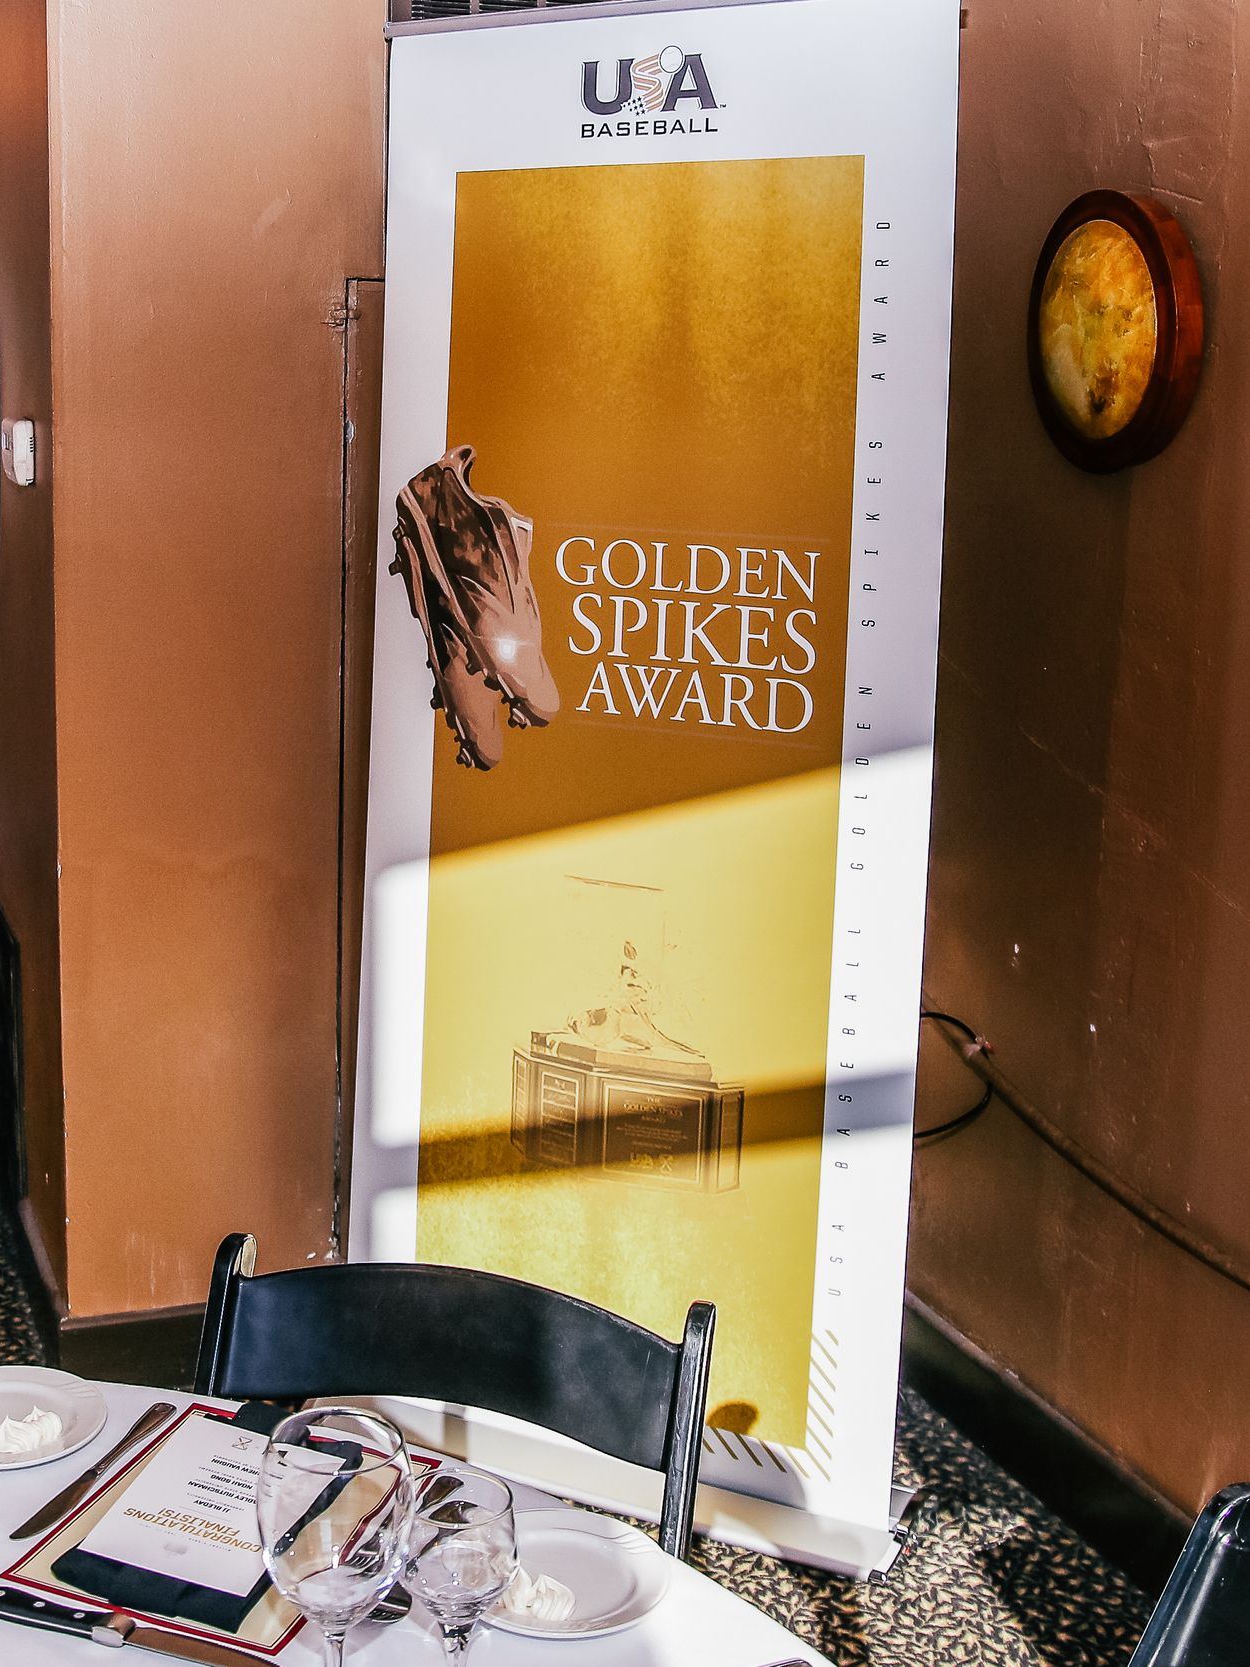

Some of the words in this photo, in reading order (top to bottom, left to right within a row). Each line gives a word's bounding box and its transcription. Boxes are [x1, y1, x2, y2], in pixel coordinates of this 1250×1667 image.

[581, 47, 719, 115] USA
[581, 118, 718, 138] BASEBALL
[870, 219, 892, 383] AWARD
[554, 536, 821, 603] GOLDEN
[861, 439, 884, 629] SPIKES
[568, 592, 817, 675] SPIKES
[576, 661, 815, 734] AWARD
[849, 684, 874, 872] GOLDEN
[834, 926, 863, 1171] BASEBALL
[123, 1507, 263, 1553] CONGRATULATIONS
[158, 1508, 240, 1537] FINALISTS!
